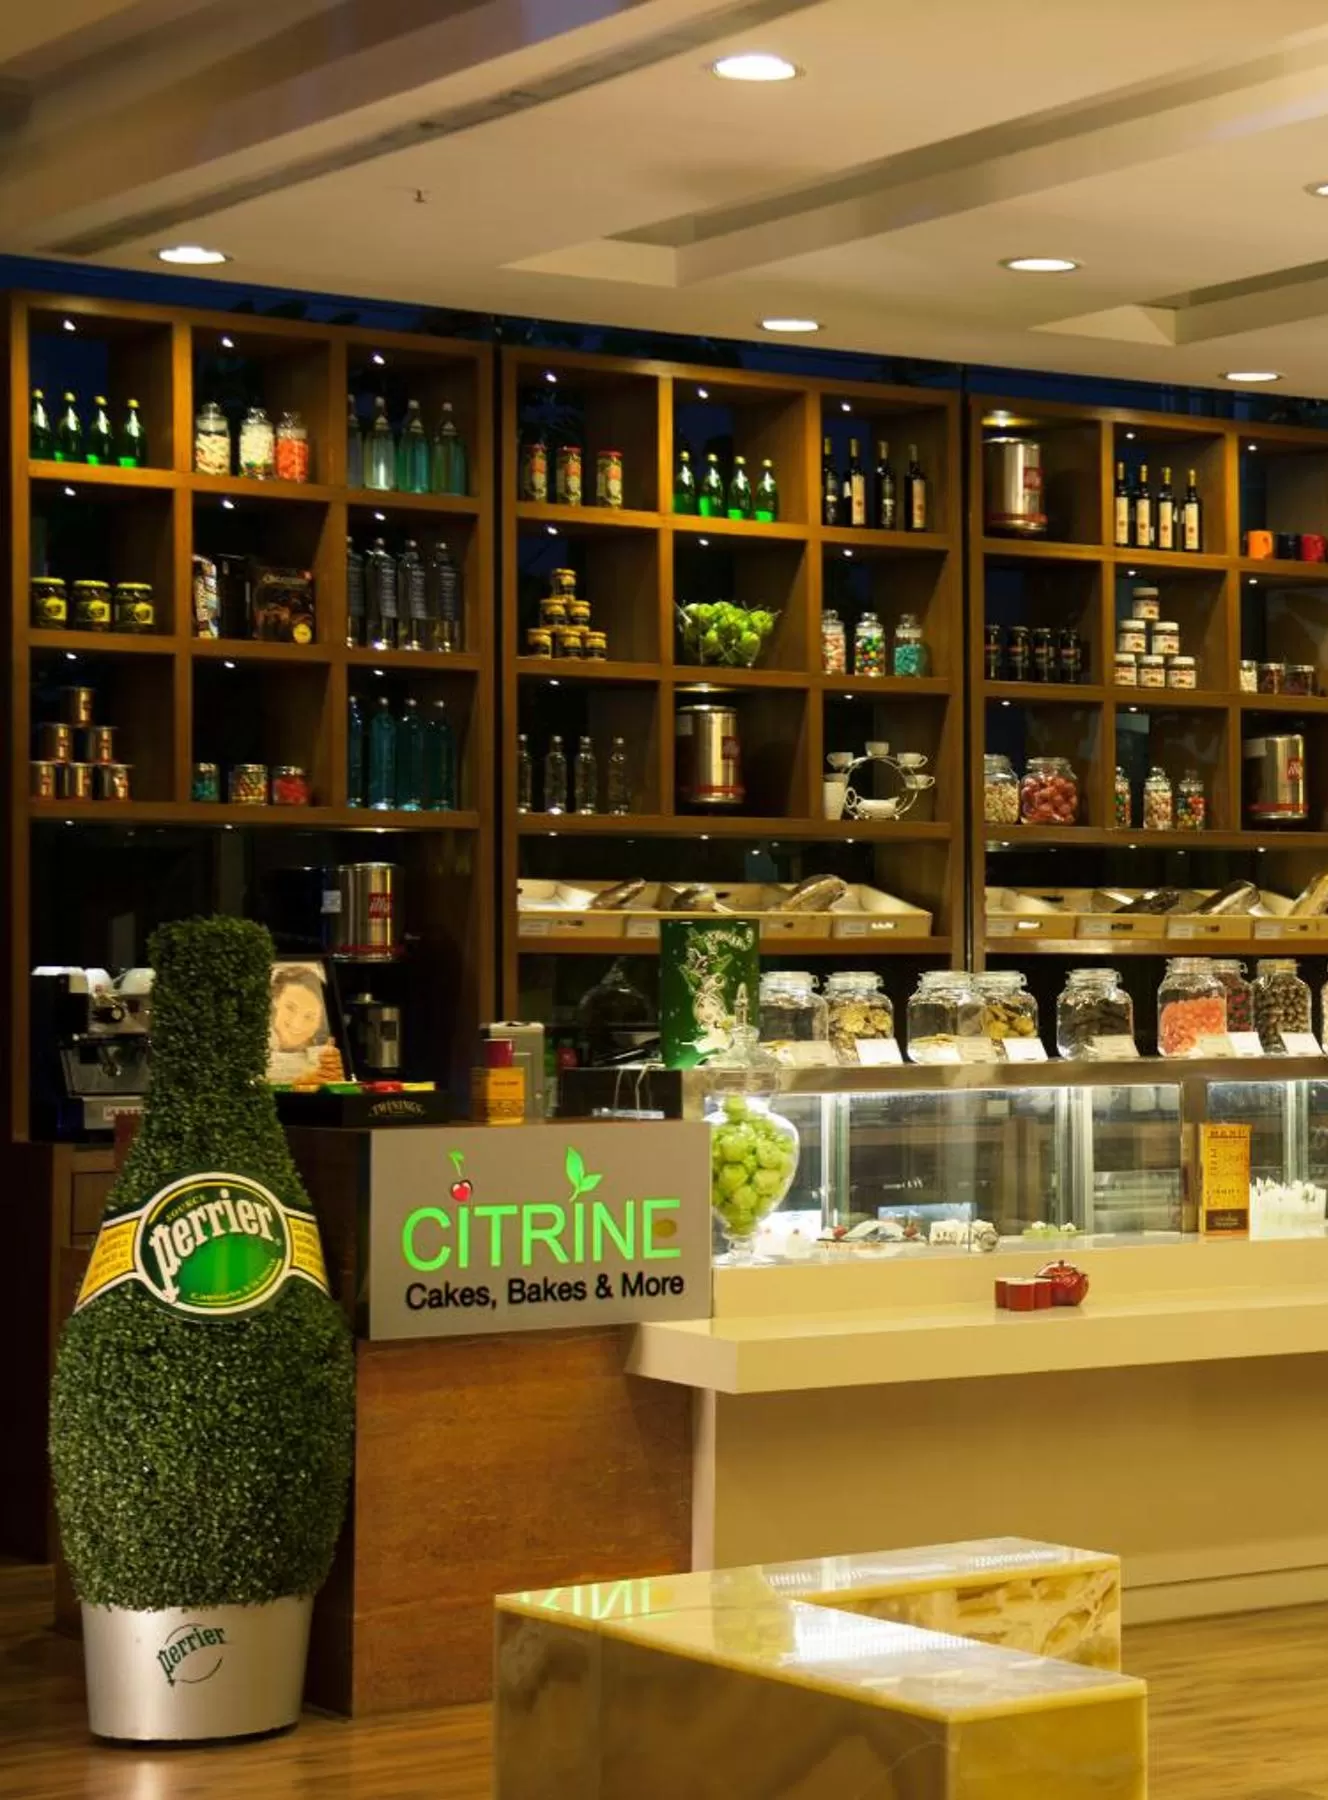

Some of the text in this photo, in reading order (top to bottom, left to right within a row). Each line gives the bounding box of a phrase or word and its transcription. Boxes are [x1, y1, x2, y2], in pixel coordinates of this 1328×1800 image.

[402, 1199, 682, 1272] CITRINE
[405, 1271, 685, 1310] Cakes, Bakes & More
[156, 1627, 228, 1687] perrier
